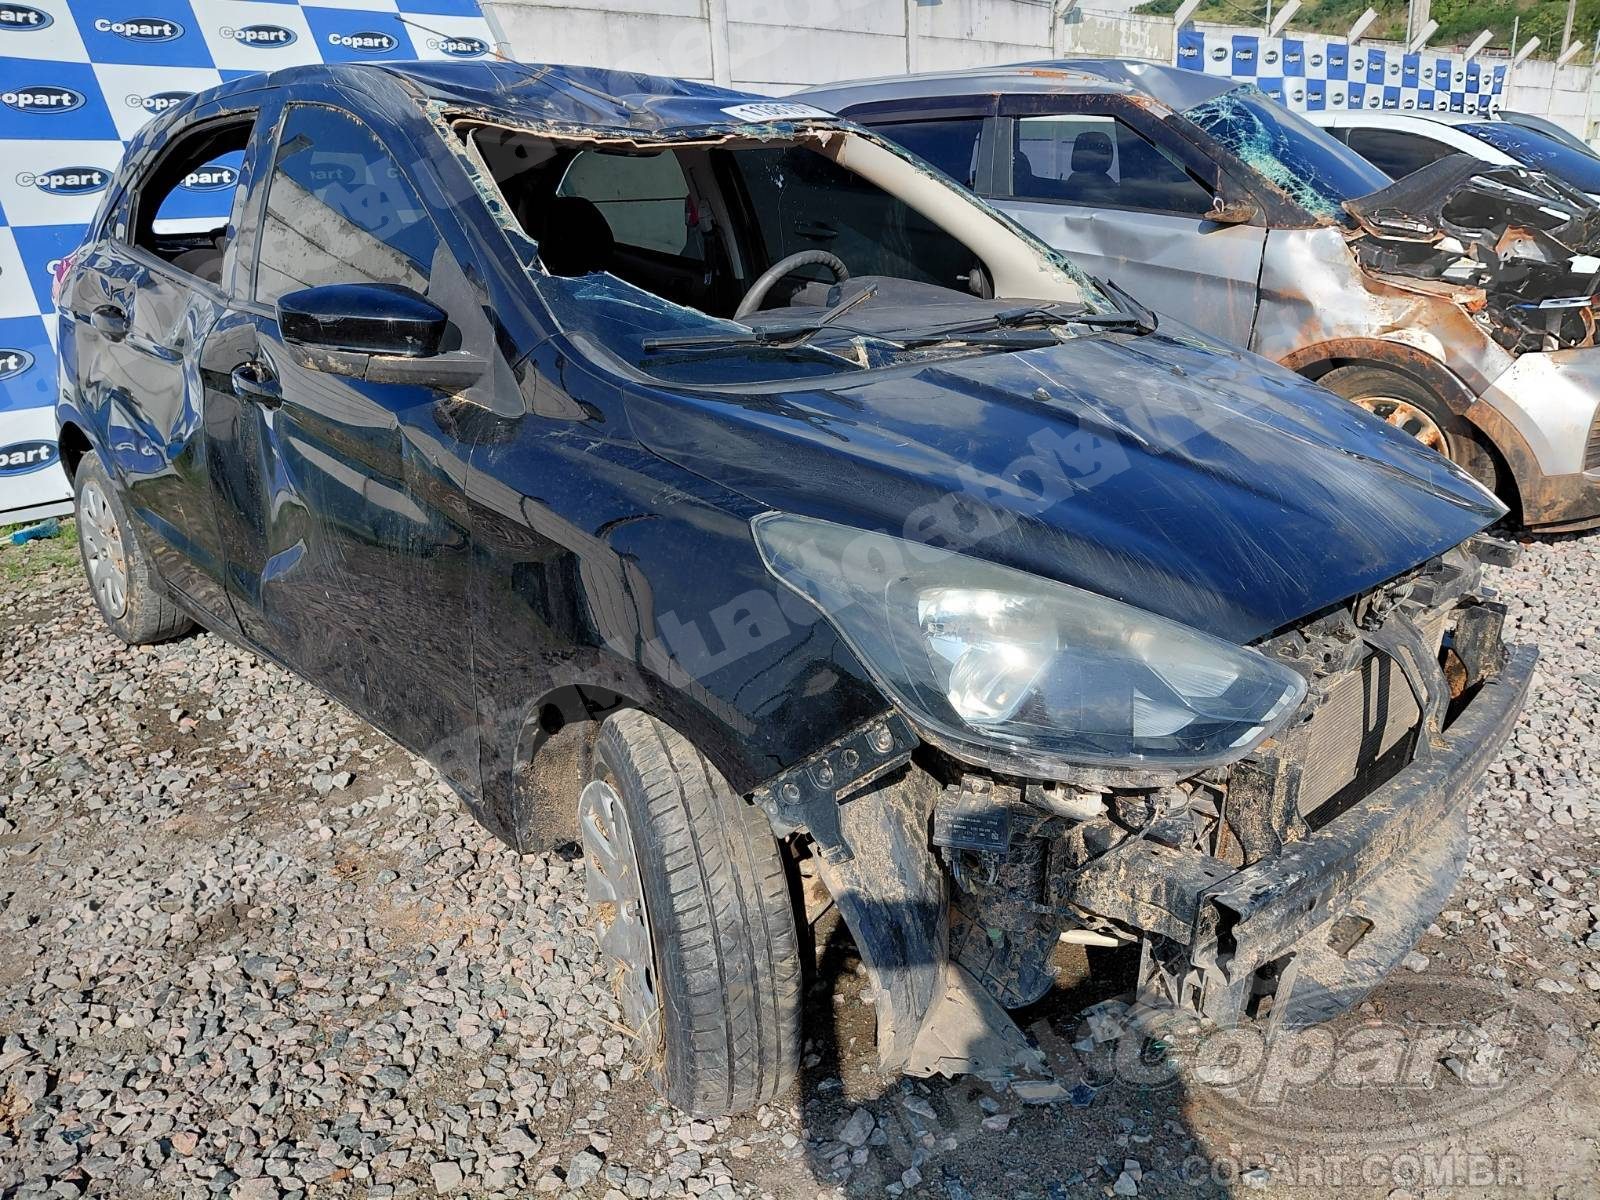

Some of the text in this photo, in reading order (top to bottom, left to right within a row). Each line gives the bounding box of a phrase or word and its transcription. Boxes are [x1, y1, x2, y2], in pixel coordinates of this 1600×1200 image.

[94, 18, 172, 36] Copart
[219, 26, 286, 42] Copart
[328, 33, 389, 48] Copart
[426, 39, 480, 52] Copart
[0, 93, 71, 107] opart
[15, 171, 101, 188] Copart
[180, 170, 231, 186] part
